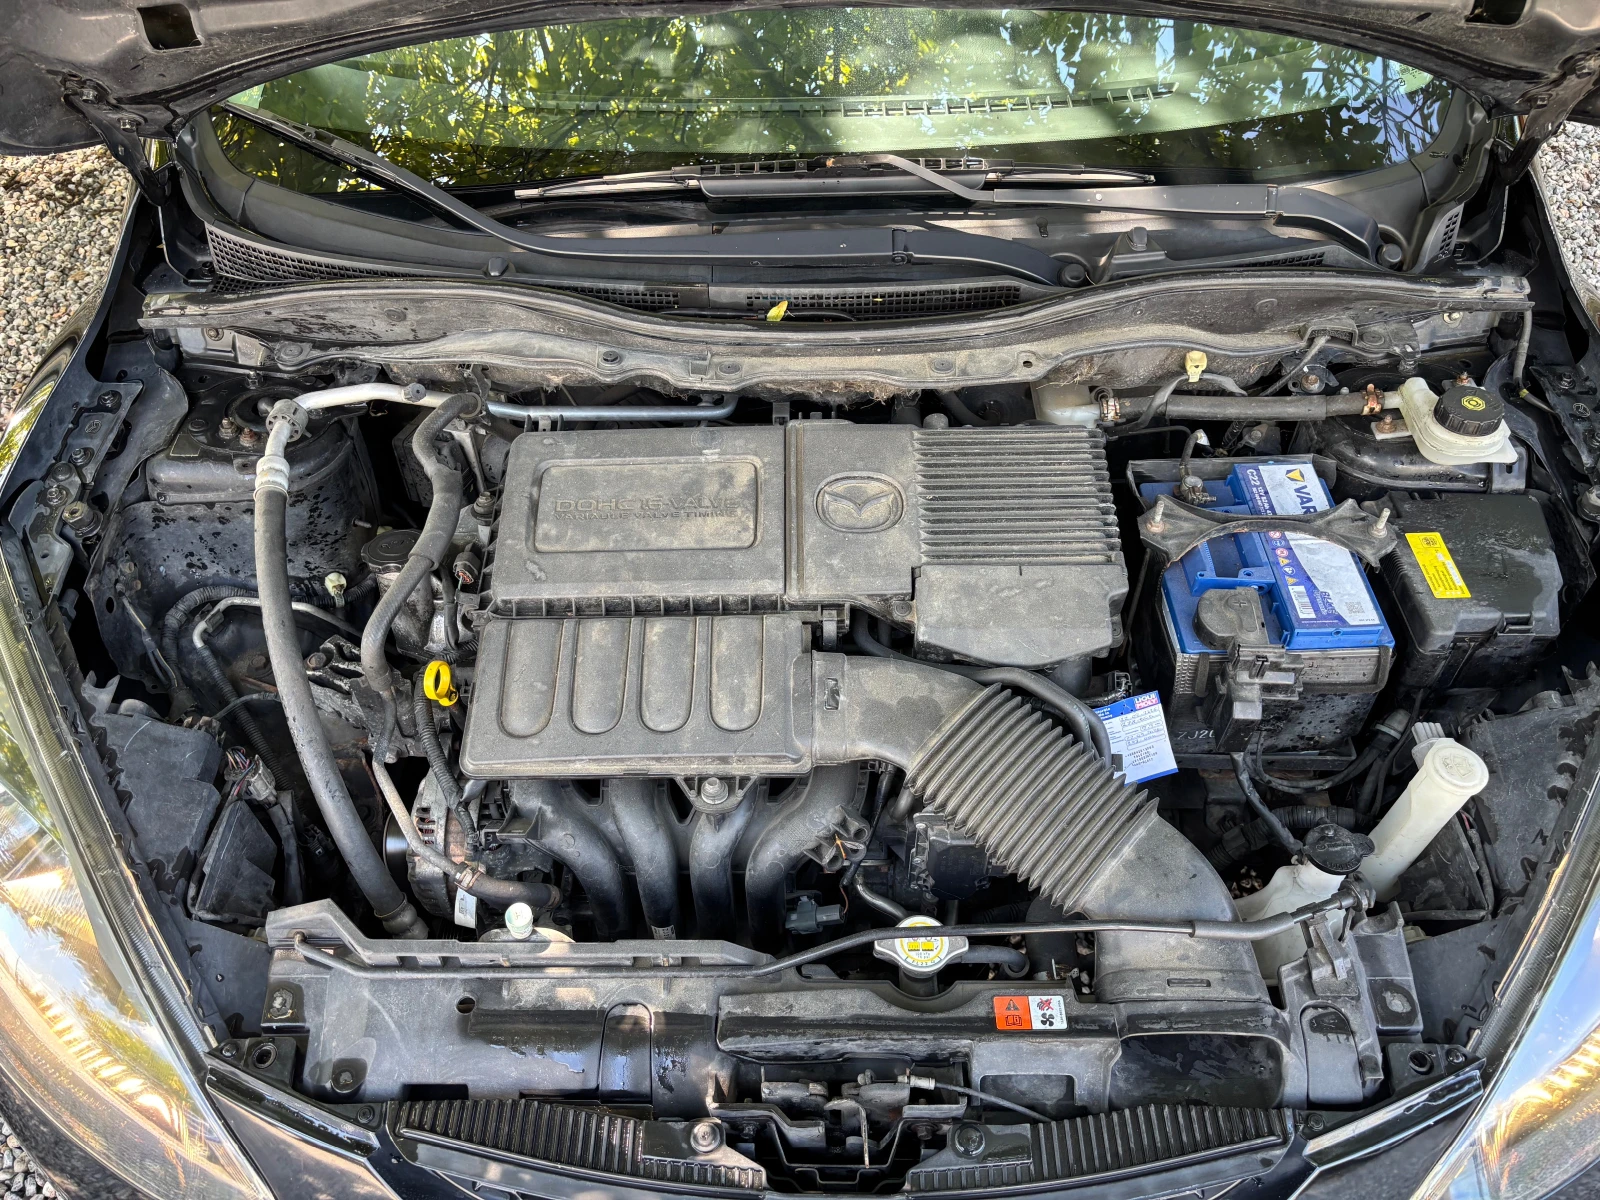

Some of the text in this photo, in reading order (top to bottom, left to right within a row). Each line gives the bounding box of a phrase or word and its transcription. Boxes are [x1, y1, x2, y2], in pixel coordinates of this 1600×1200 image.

[1246, 468, 1260, 486] C22
[555, 498, 636, 512] DOHC
[555, 510, 739, 520] VARIABLE VALVE TIMING
